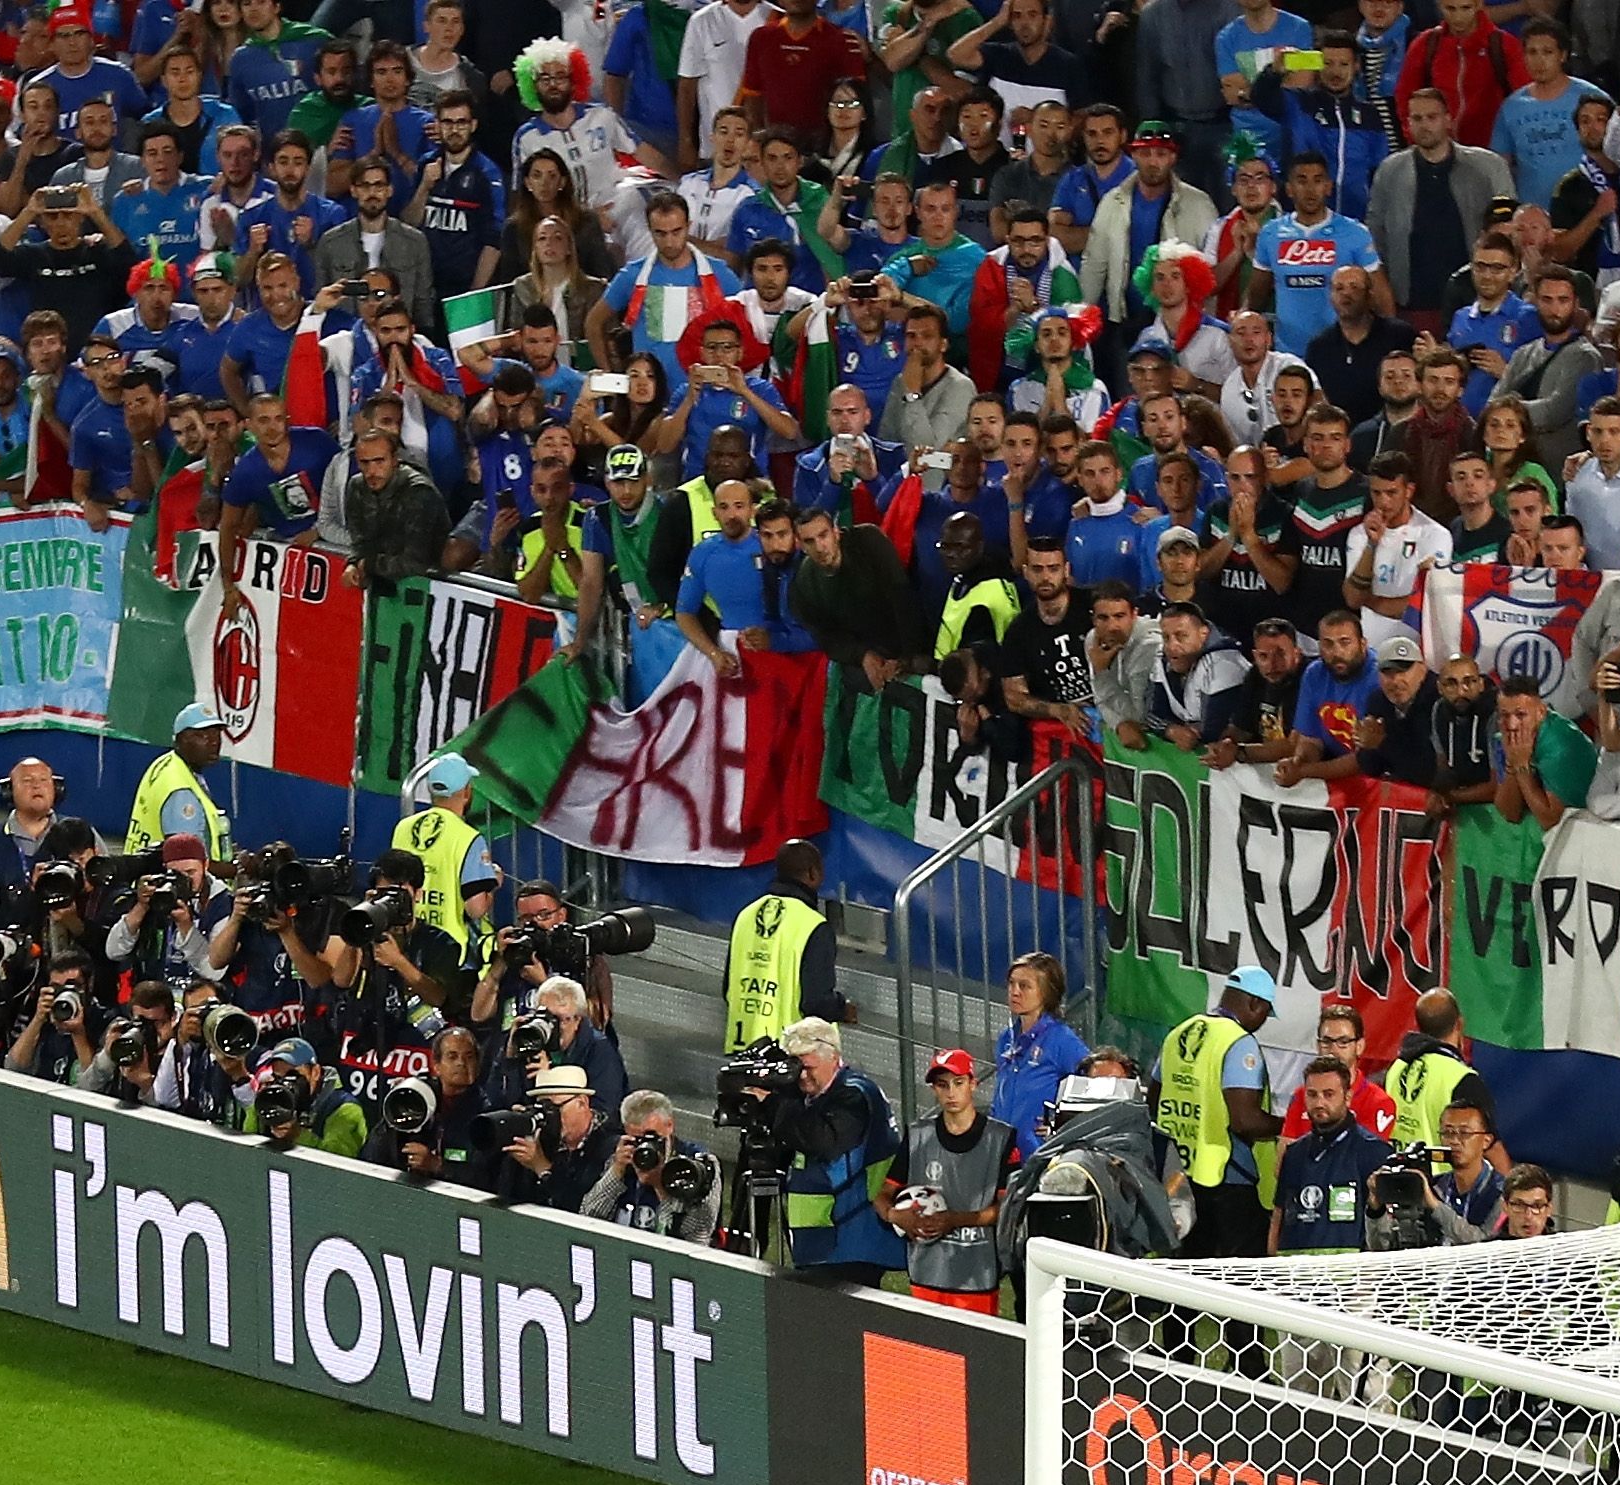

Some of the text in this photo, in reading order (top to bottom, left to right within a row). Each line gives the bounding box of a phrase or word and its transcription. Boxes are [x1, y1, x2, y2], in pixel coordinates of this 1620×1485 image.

[424, 204, 468, 233] TALIA
[1279, 240, 1336, 266] Lete
[843, 351, 860, 374] 9
[503, 453, 523, 481] 8
[610, 452, 637, 467] 46
[176, 535, 330, 605] ADRID
[1105, 757, 1447, 1001] SALERNO
[52, 1113, 231, 1350] i'm
[269, 1169, 596, 1438] lovin'
[630, 1258, 717, 1478] it
